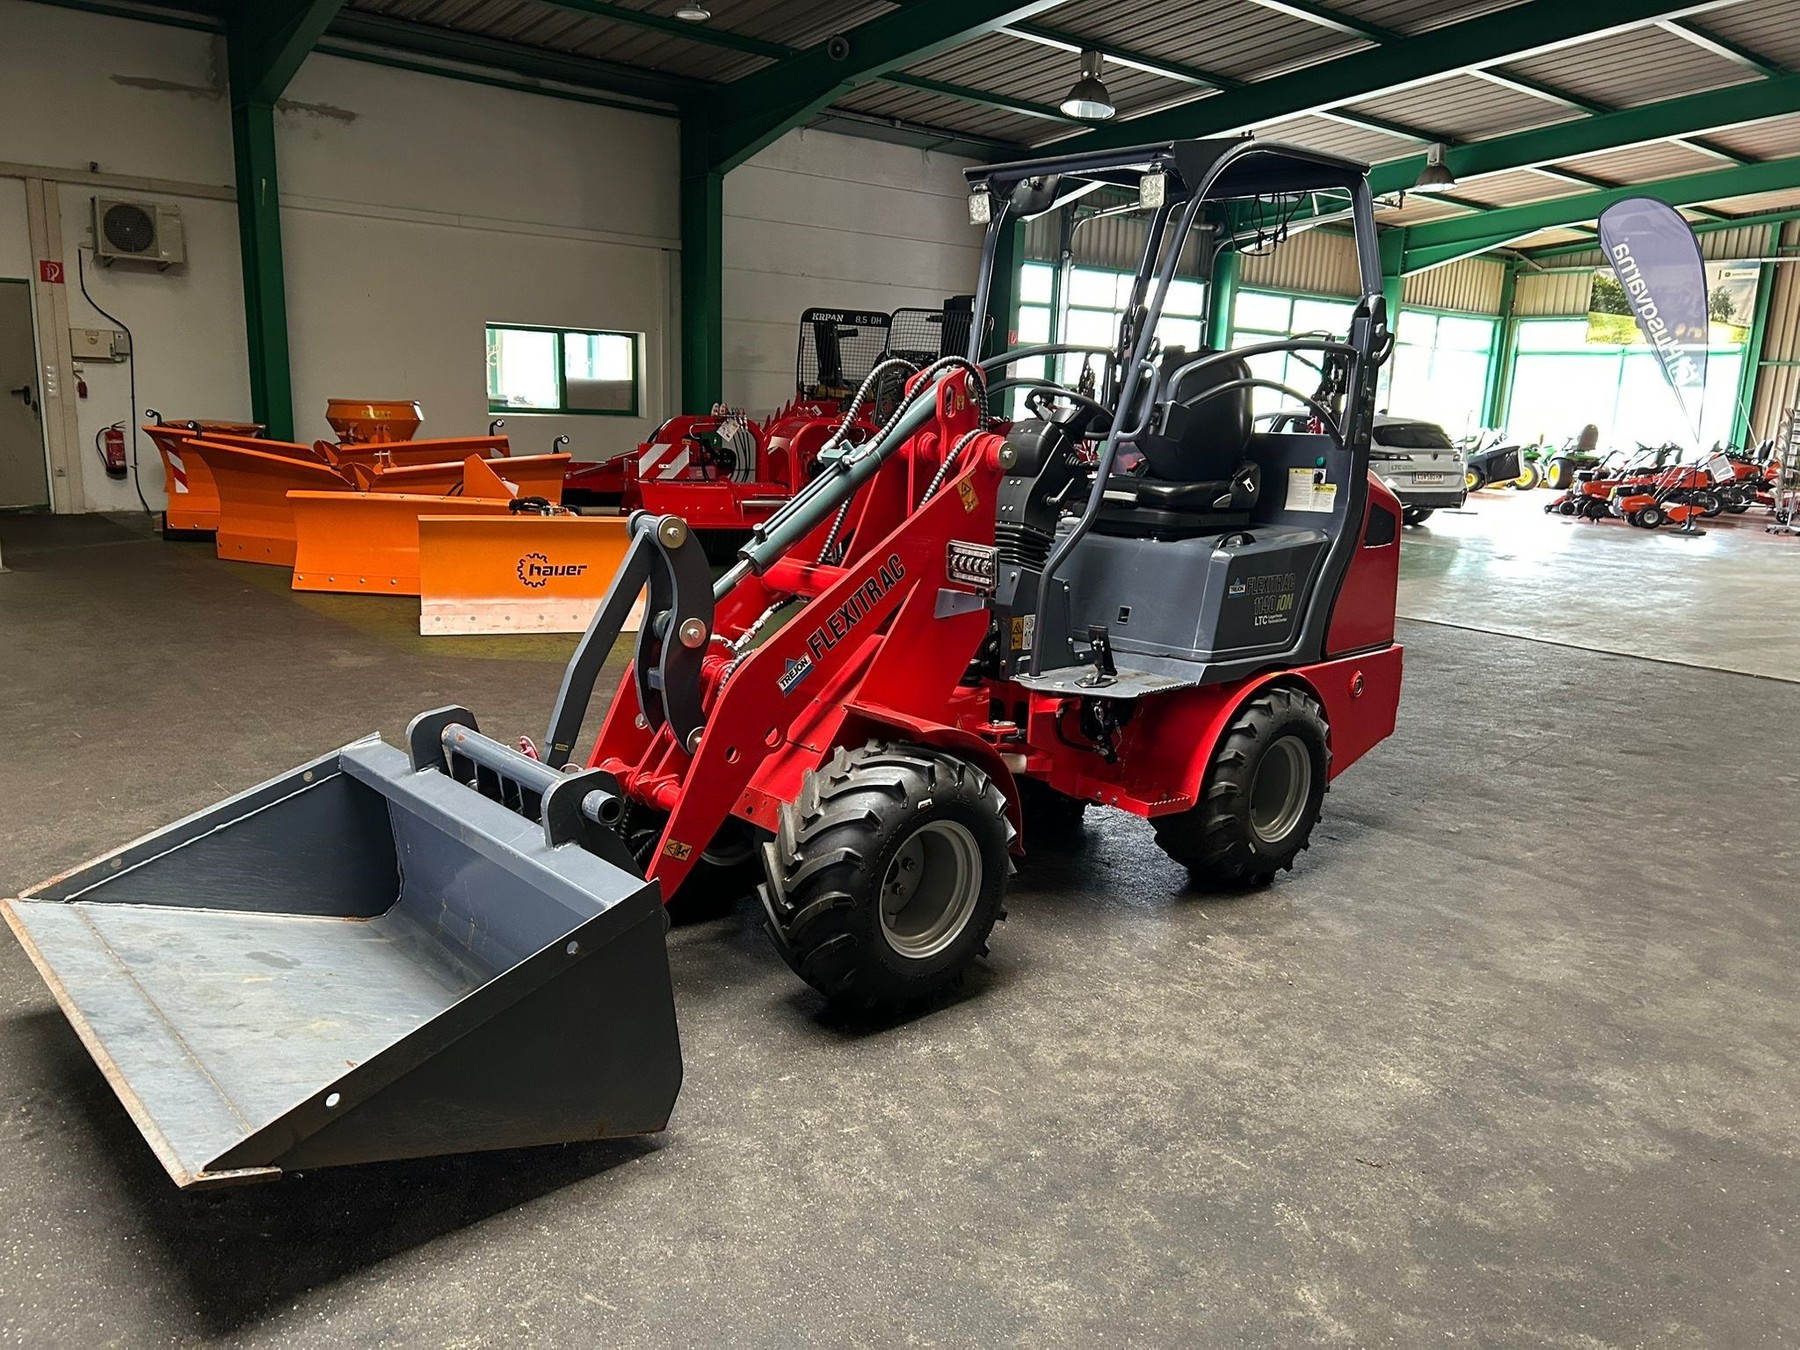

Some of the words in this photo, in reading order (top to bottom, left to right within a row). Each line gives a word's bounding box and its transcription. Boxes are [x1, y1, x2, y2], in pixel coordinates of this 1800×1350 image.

[812, 312, 844, 322] KRPAN
[855, 315, 868, 324] 8.5
[870, 316, 882, 325] DH
[529, 564, 588, 576] hauer
[1246, 573, 1296, 595] FLEXITRAC
[1254, 595, 1277, 615] 1140
[779, 657, 810, 688] TREJON
[806, 553, 906, 662] FLEXITRAC
[1254, 615, 1268, 626] LTC
